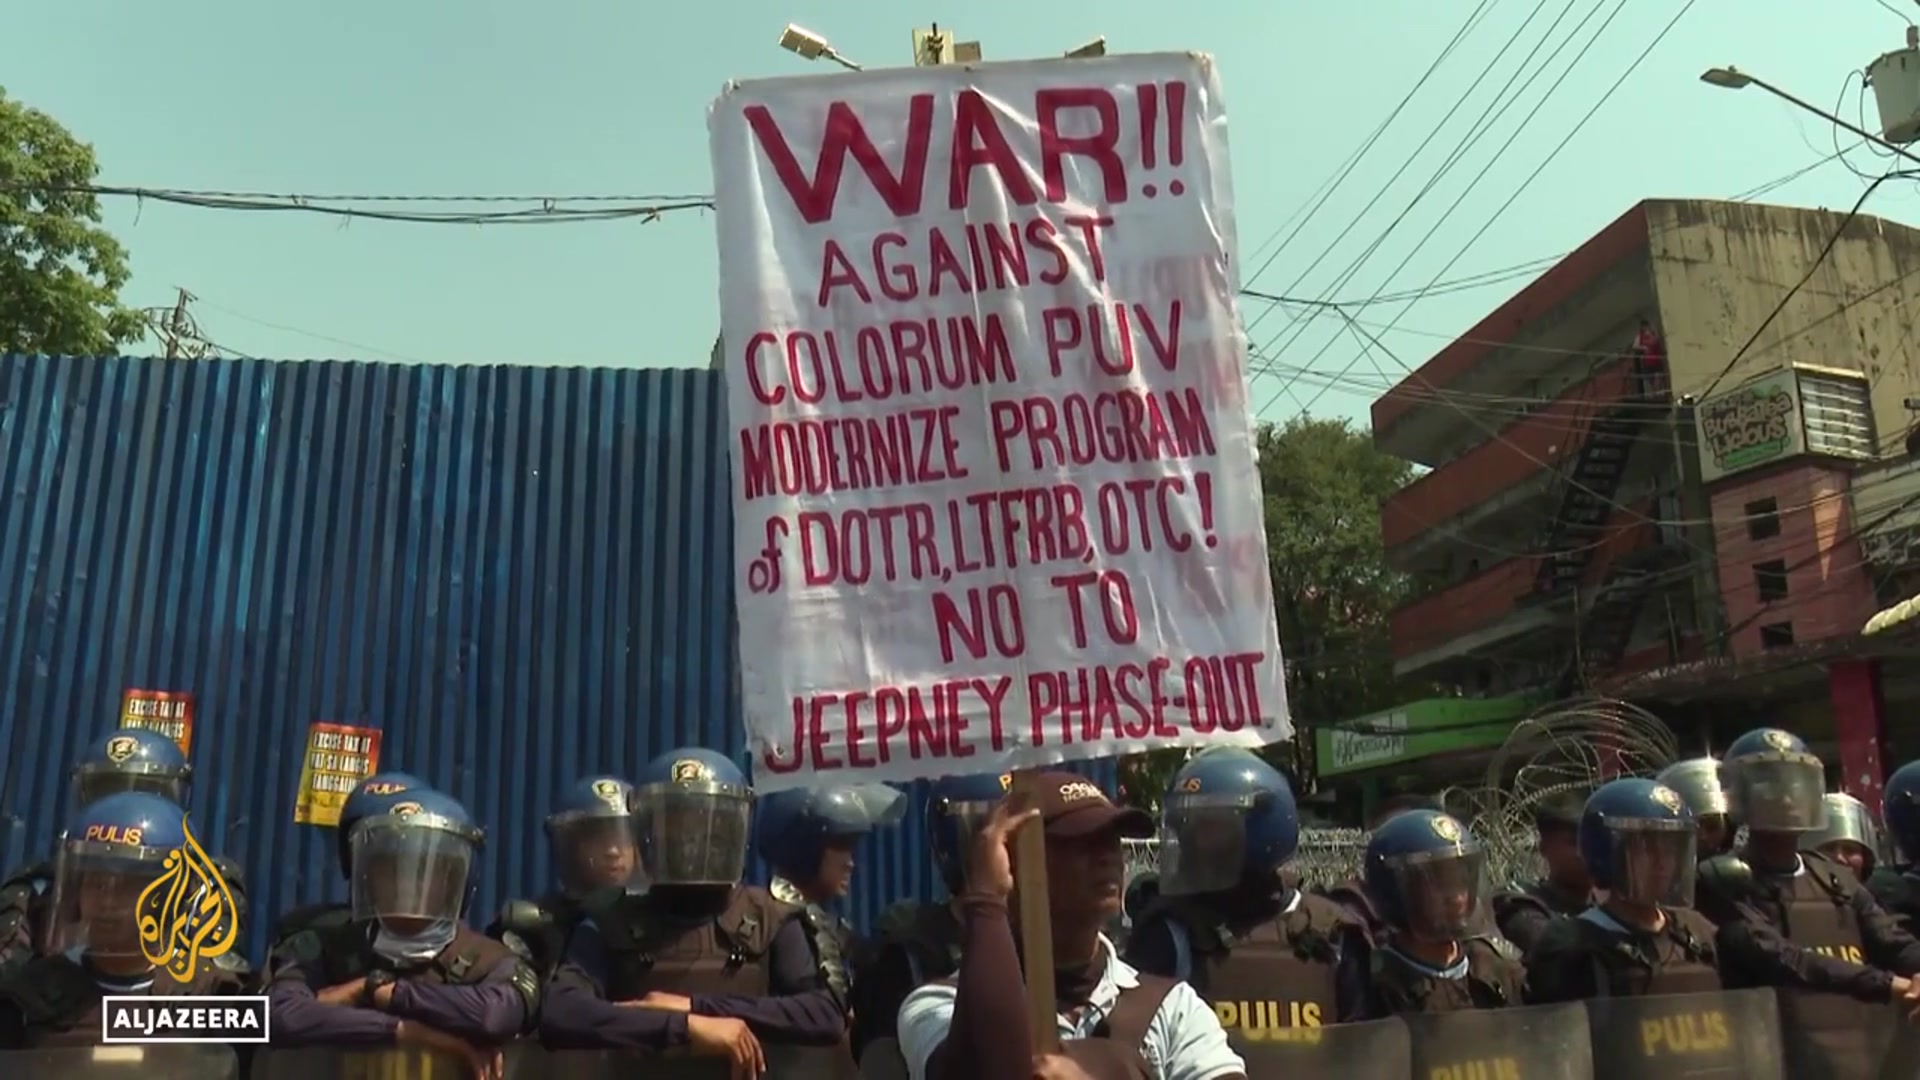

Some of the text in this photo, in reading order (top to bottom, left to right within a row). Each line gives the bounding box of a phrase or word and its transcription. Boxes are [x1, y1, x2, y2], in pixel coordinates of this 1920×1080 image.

[743, 82, 1186, 223] WAR!!
[818, 216, 1115, 307] AGAINST
[745, 300, 1182, 406] COLORUM PUV
[740, 387, 1217, 499] MODERNIZE PROGRAM
[748, 515, 789, 594] of
[932, 569, 1138, 664] NO TO
[764, 651, 1264, 775] JEEPNEY PHASE-OUT
[85, 825, 143, 845] PULIS
[1217, 1000, 1323, 1043] PULIS
[1640, 1010, 1730, 1057] PULIS
